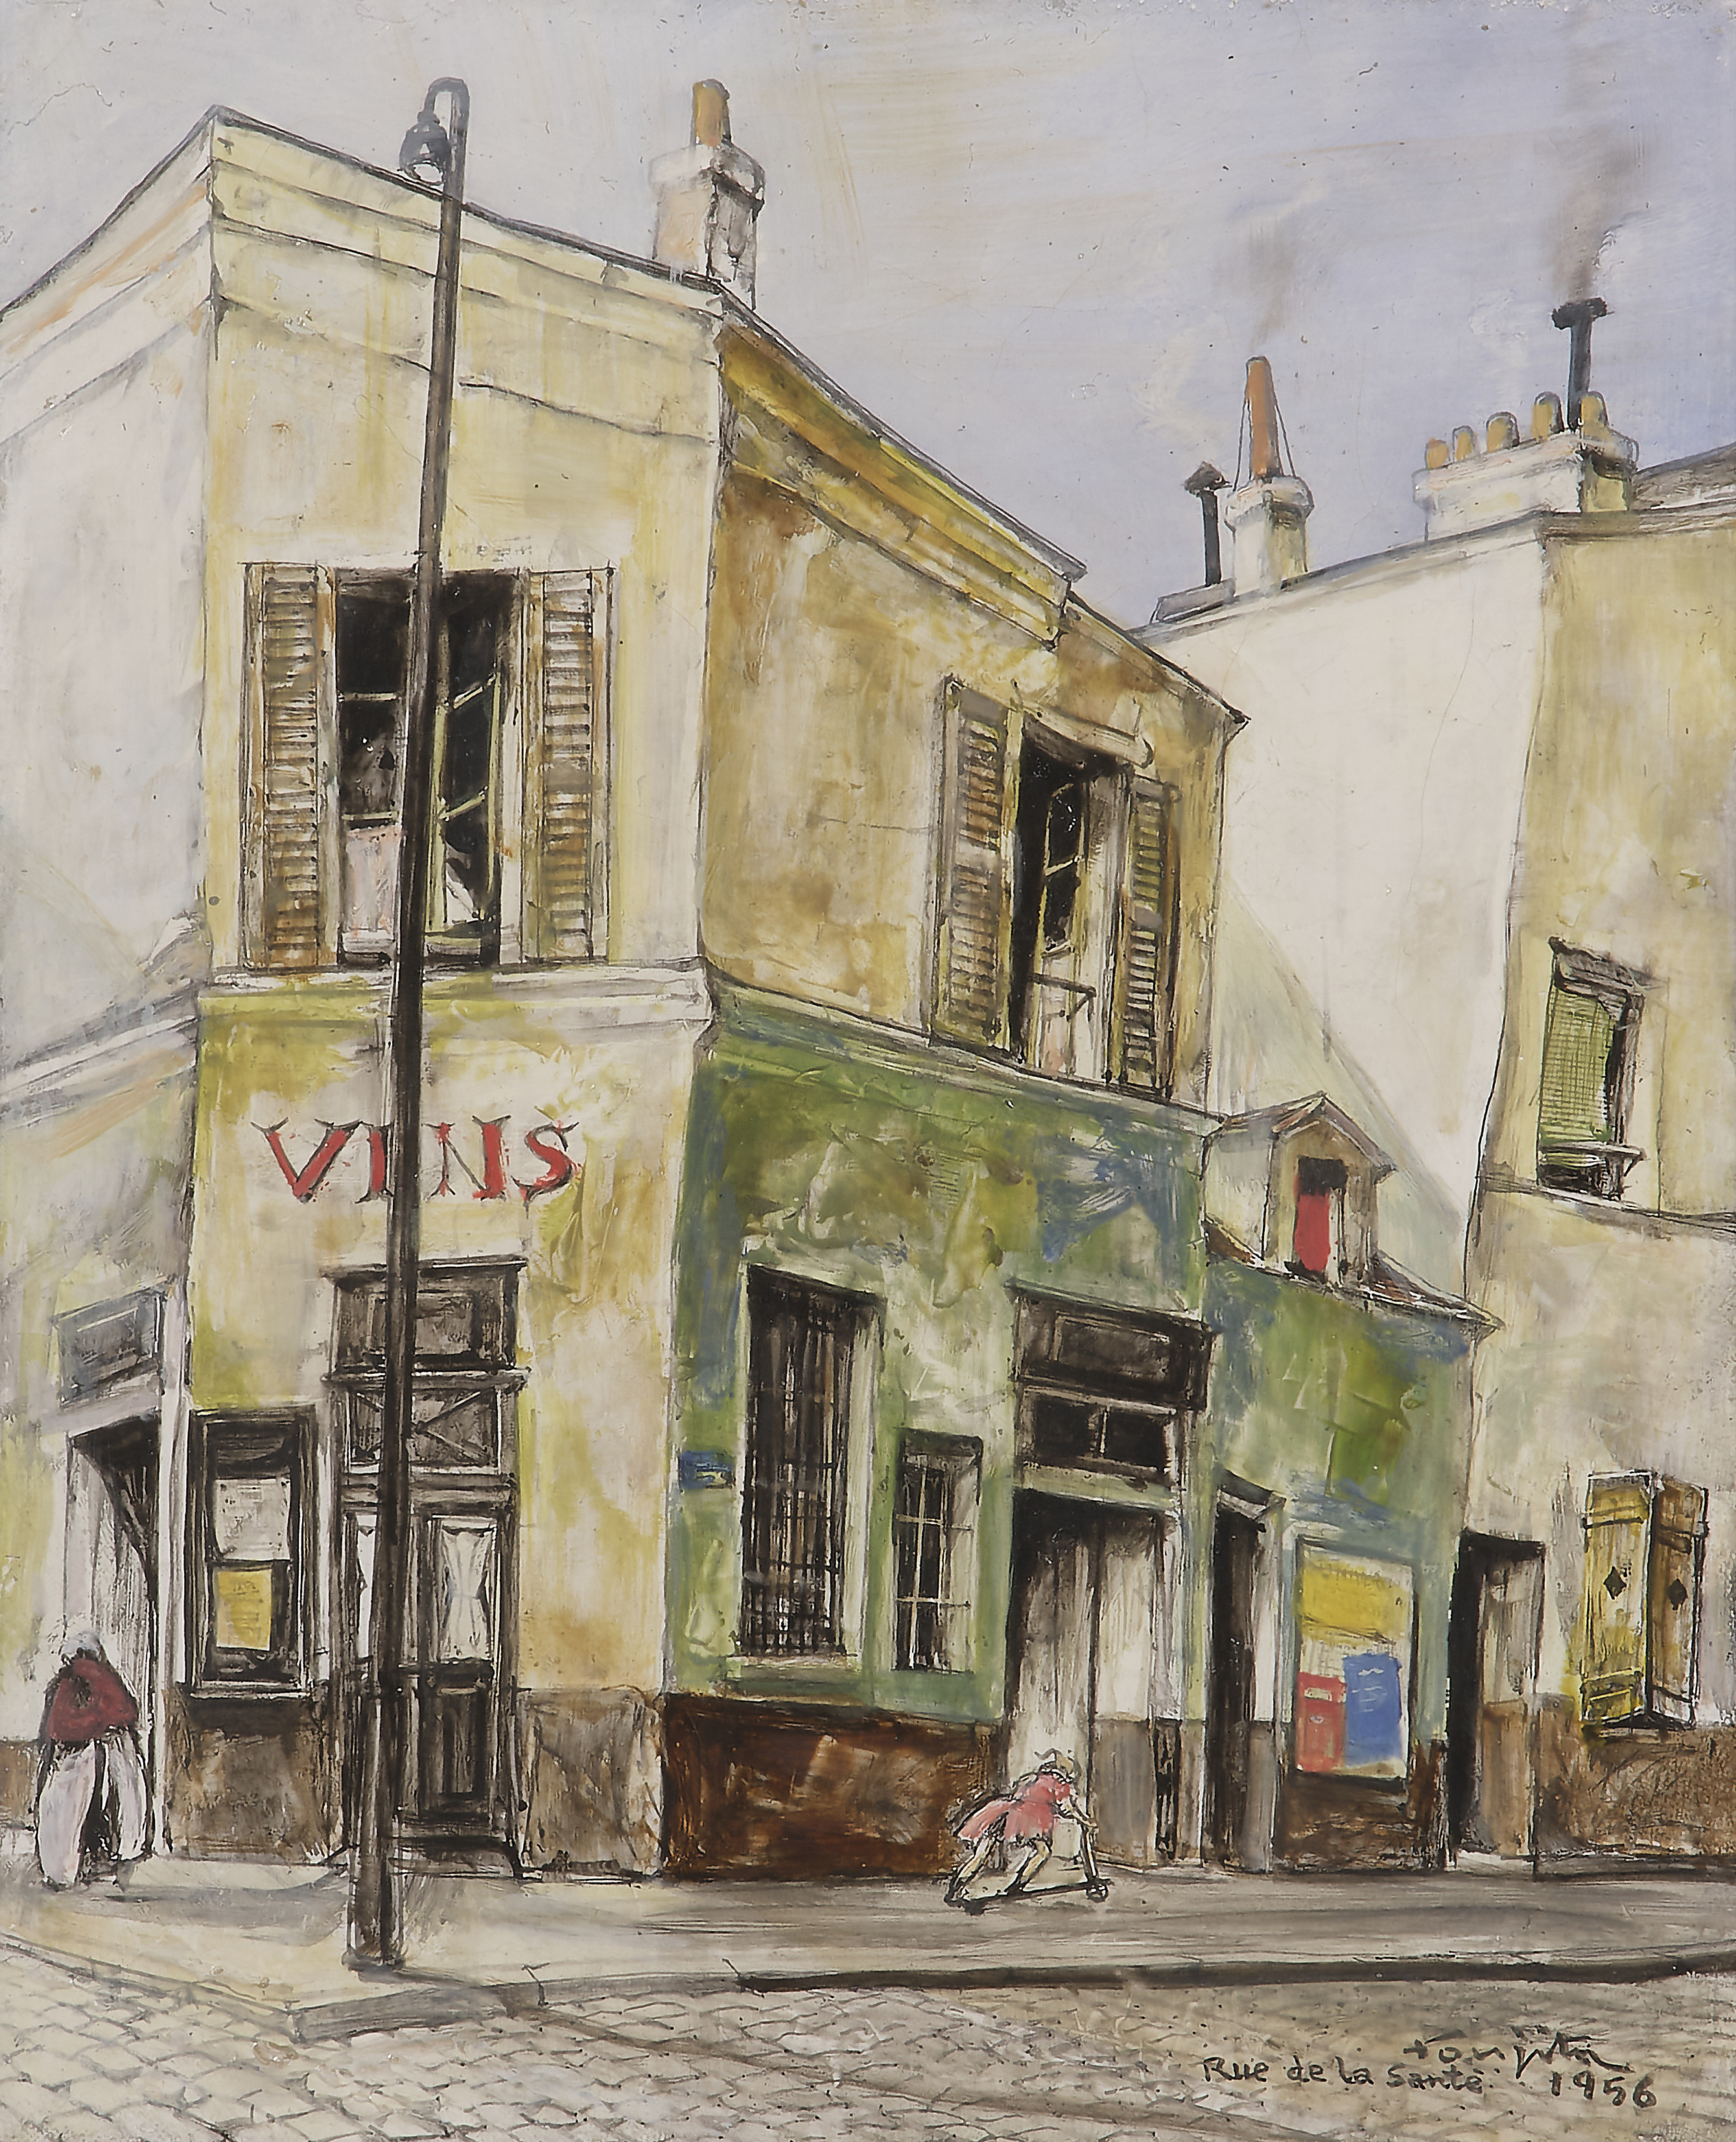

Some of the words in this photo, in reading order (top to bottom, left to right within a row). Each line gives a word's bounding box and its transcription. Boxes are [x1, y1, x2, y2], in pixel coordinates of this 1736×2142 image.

[251, 1114, 580, 1204] VINS
[1203, 2056, 1269, 2082] Rue
[1287, 2054, 1327, 2083] de
[1335, 2056, 1374, 2085] la
[1549, 2069, 1658, 2109] 1956
